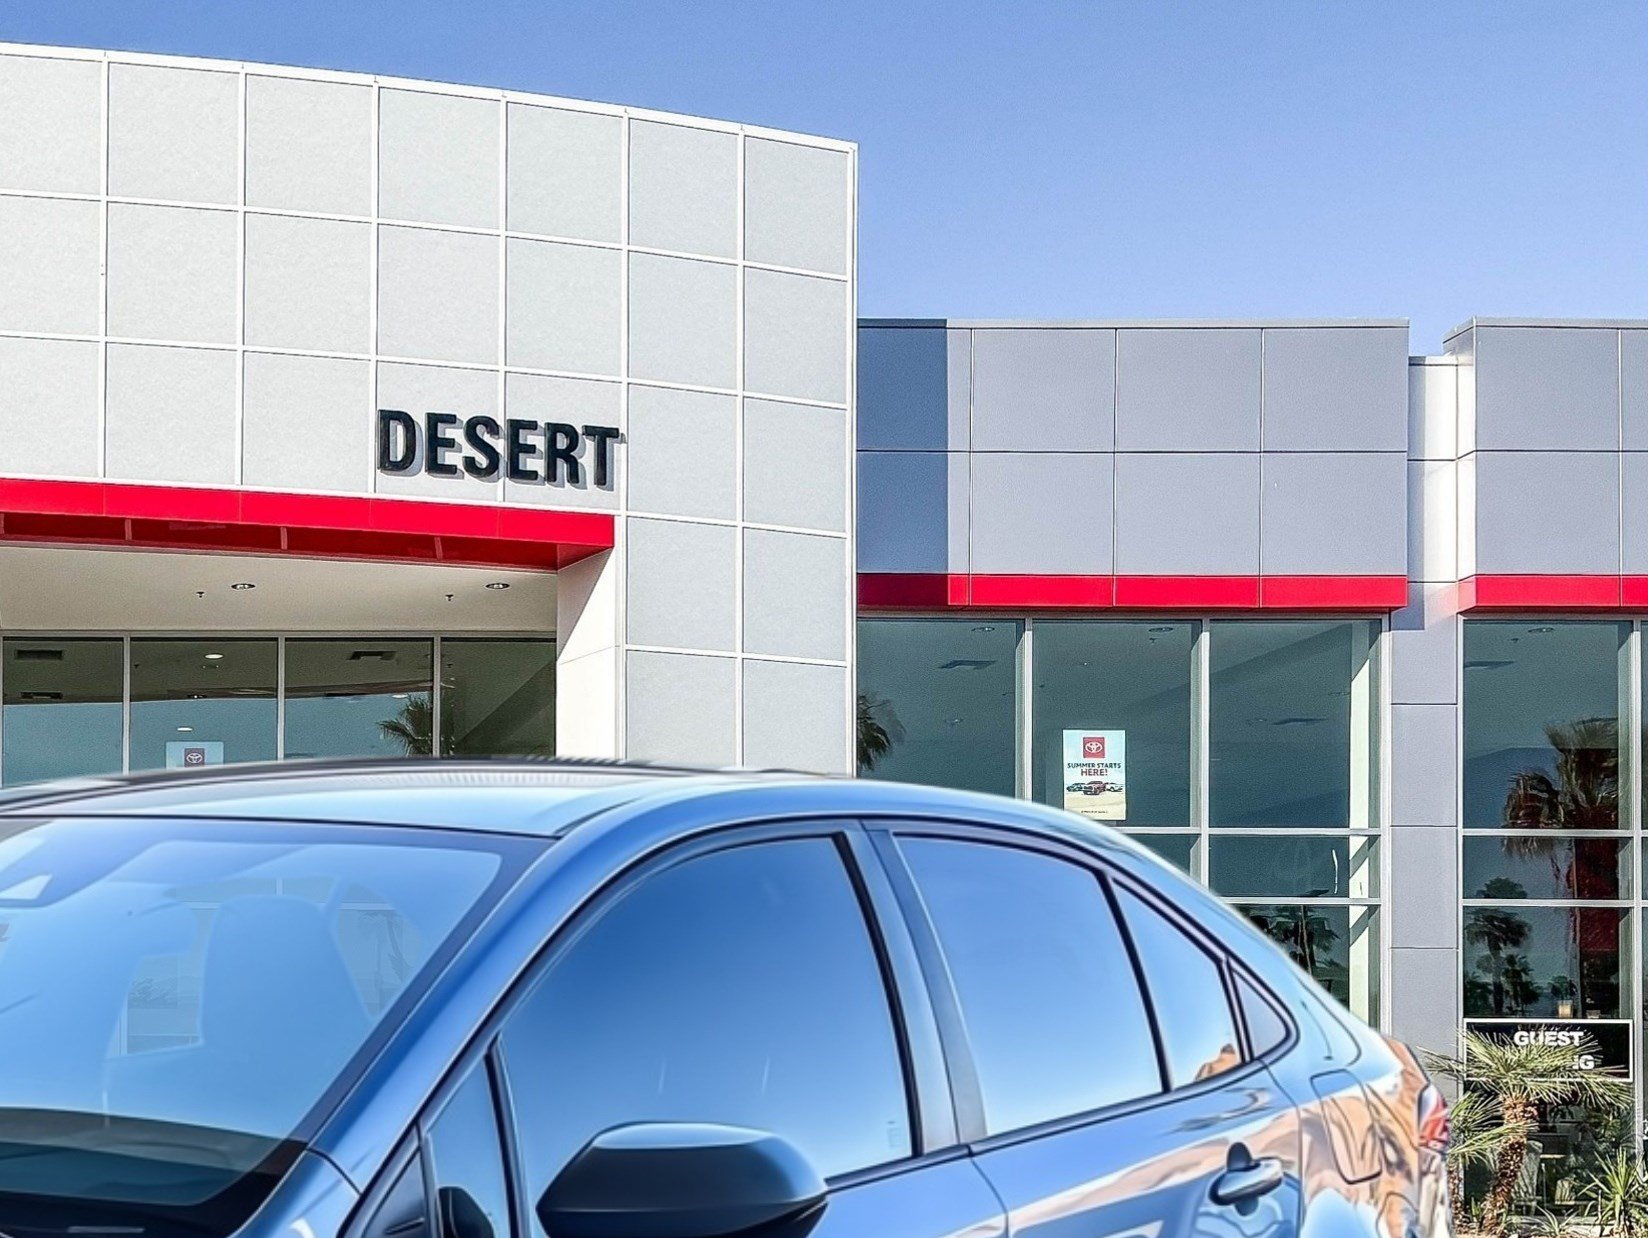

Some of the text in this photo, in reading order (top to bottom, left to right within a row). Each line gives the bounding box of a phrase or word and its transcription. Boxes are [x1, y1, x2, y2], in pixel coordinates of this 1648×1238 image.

[377, 409, 620, 487] DESERT
[1080, 768, 1108, 776] HERE!
[1513, 1030, 1585, 1047] GUEST
